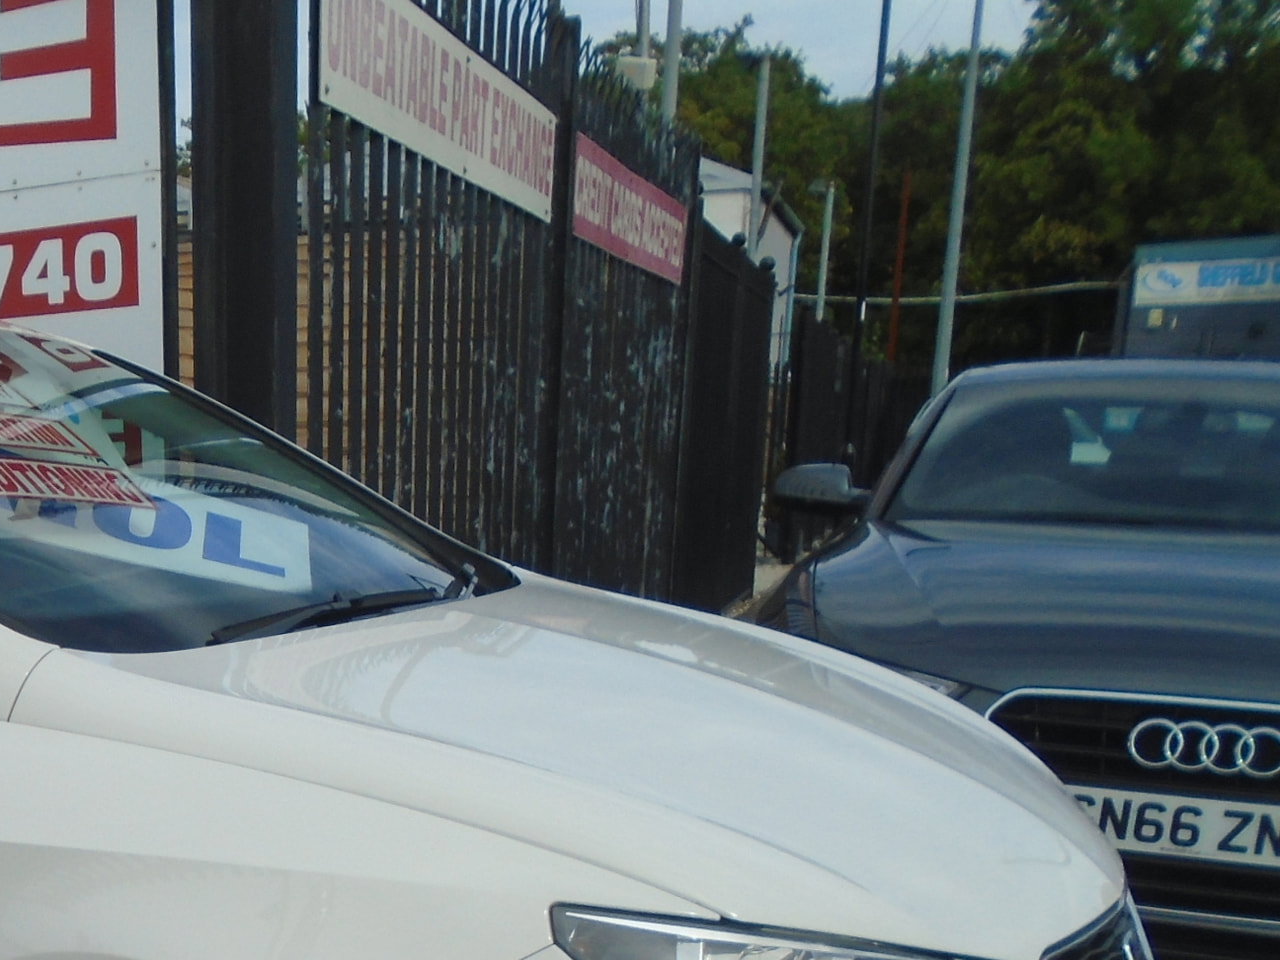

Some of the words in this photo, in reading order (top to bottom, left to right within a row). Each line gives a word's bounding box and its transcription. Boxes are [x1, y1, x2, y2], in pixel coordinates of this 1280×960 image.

[328, 0, 450, 136] UNBEATABLE
[451, 57, 489, 159] PART
[490, 88, 554, 197] EXCHANGE
